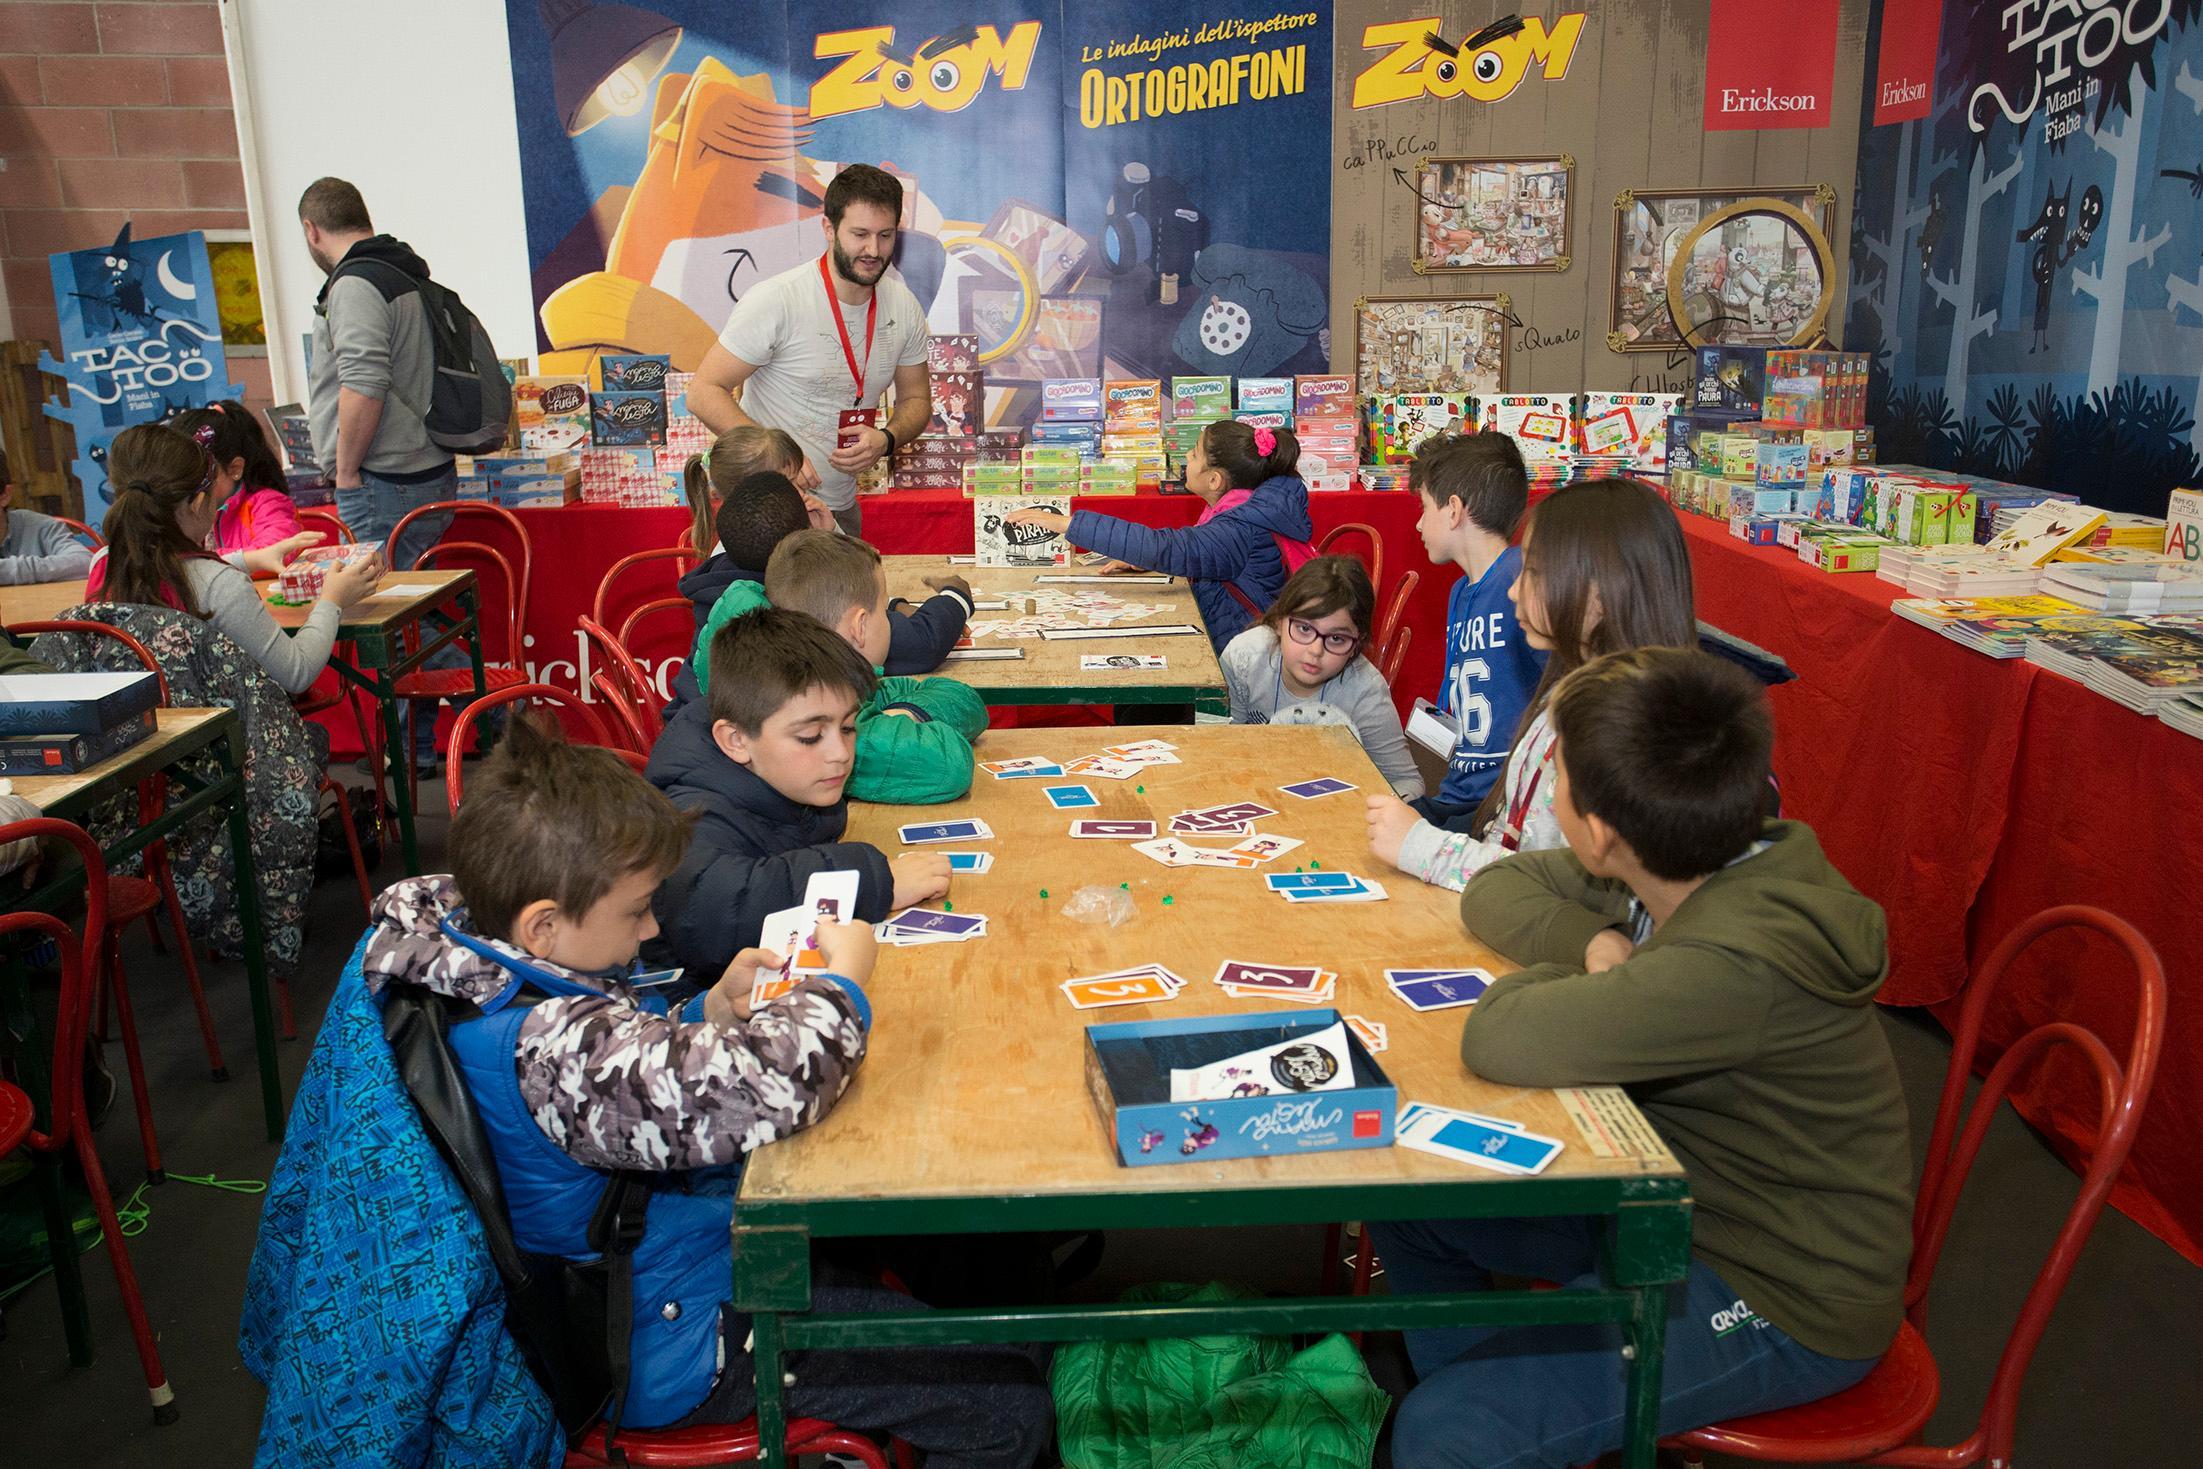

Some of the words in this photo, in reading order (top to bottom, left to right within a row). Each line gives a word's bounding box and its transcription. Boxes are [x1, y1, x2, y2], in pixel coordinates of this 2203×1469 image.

[1081, 46, 1103, 63] Le
[1107, 28, 1190, 62] indagini
[1194, 12, 1318, 45] dell'ispettore
[809, 20, 1042, 118] ZOOM
[1352, 12, 1588, 110] ZOOM
[1080, 44, 1306, 129] ORTOGRAFONI
[1881, 78, 1926, 108] Erickson
[2044, 79, 2083, 117] Mani
[2085, 75, 2099, 98] in
[1720, 88, 1816, 113] Erickson
[2044, 114, 2082, 144] Fiaba
[71, 340, 171, 373] TAC
[1177, 382, 1223, 396] GIOCADOMINO
[1243, 384, 1286, 397] GIOCADOMINO
[1302, 380, 1348, 395] GIOCADOMINO
[1698, 390, 1722, 402] PAURA
[553, 395, 580, 411] FUGA
[1398, 396, 1443, 406] TABLOTTO
[1502, 396, 1548, 406] TABLOTTO
[1610, 395, 1655, 406] TABLOTTO
